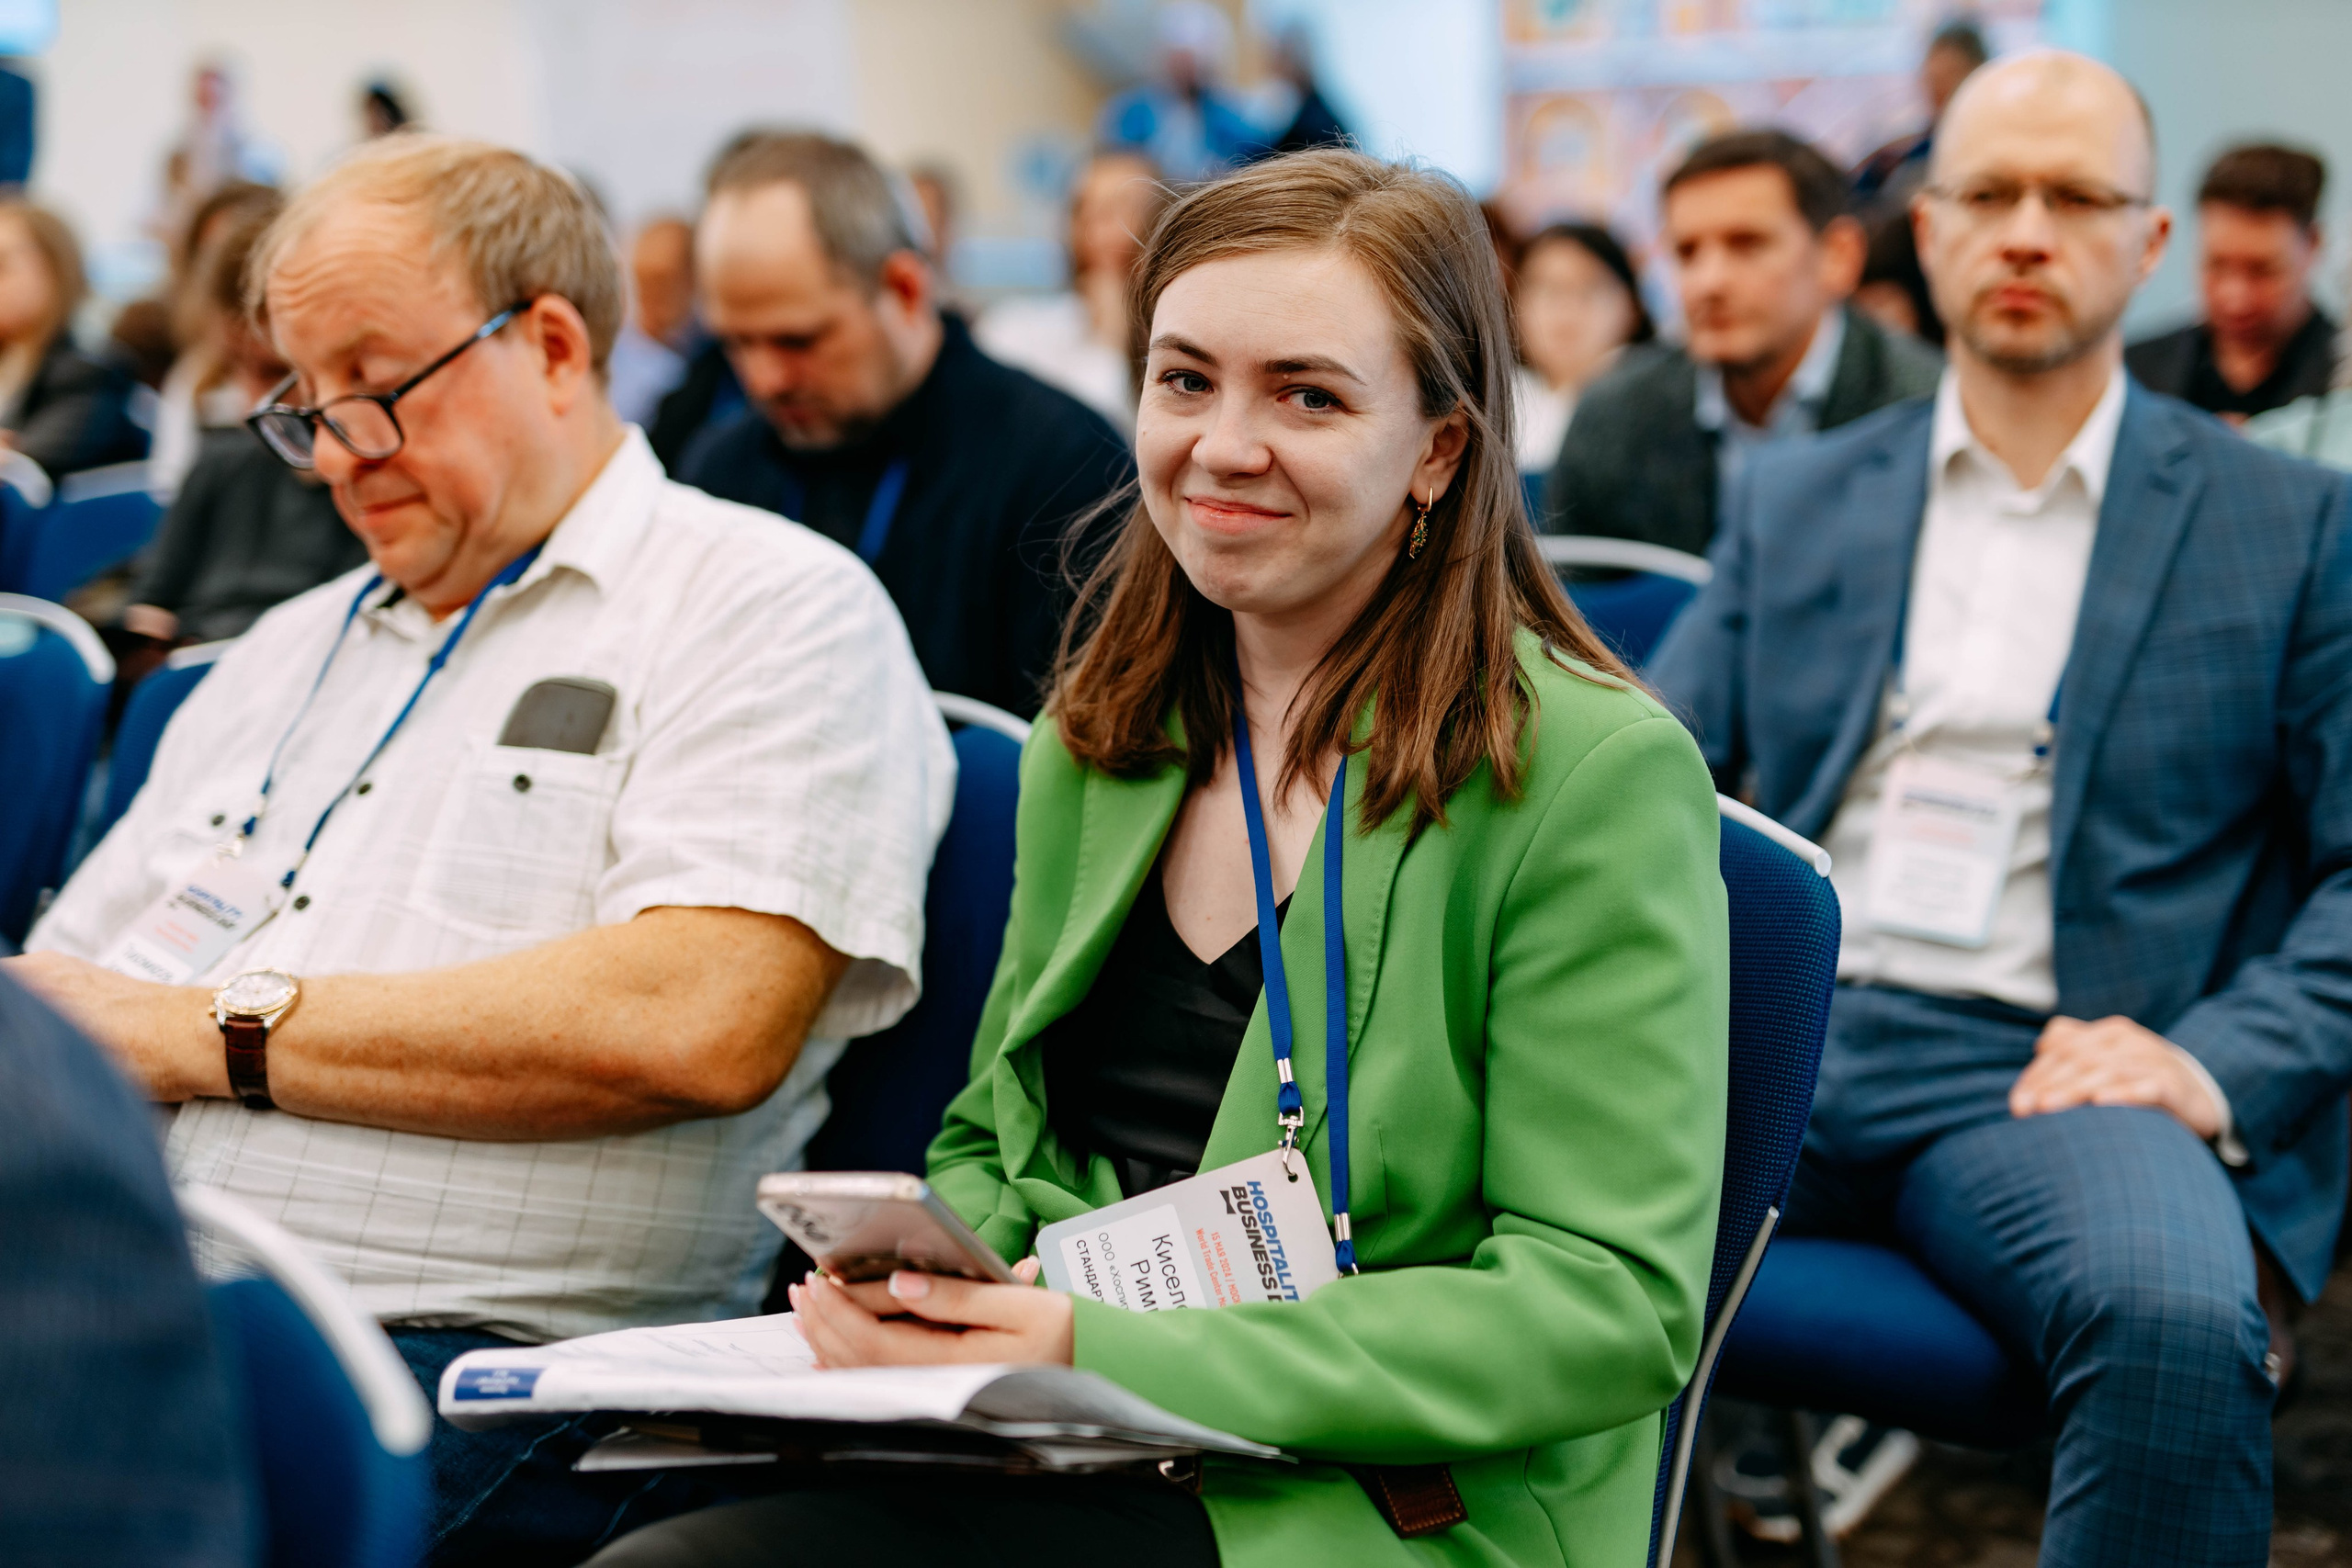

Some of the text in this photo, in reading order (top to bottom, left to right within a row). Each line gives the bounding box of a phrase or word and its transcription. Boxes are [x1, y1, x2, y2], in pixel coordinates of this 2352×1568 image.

[1098, 1232, 1115, 1261] ООО
[1211, 1232, 1221, 1242] 15
[1231, 1186, 1278, 1291] BUSINESS
[1215, 1241, 1227, 1258] МАЯ
[1195, 1228, 1205, 1249] World
[1203, 1249, 1214, 1271] Trade
[1210, 1271, 1223, 1296] Center
[1219, 1258, 1232, 1278] 2024
